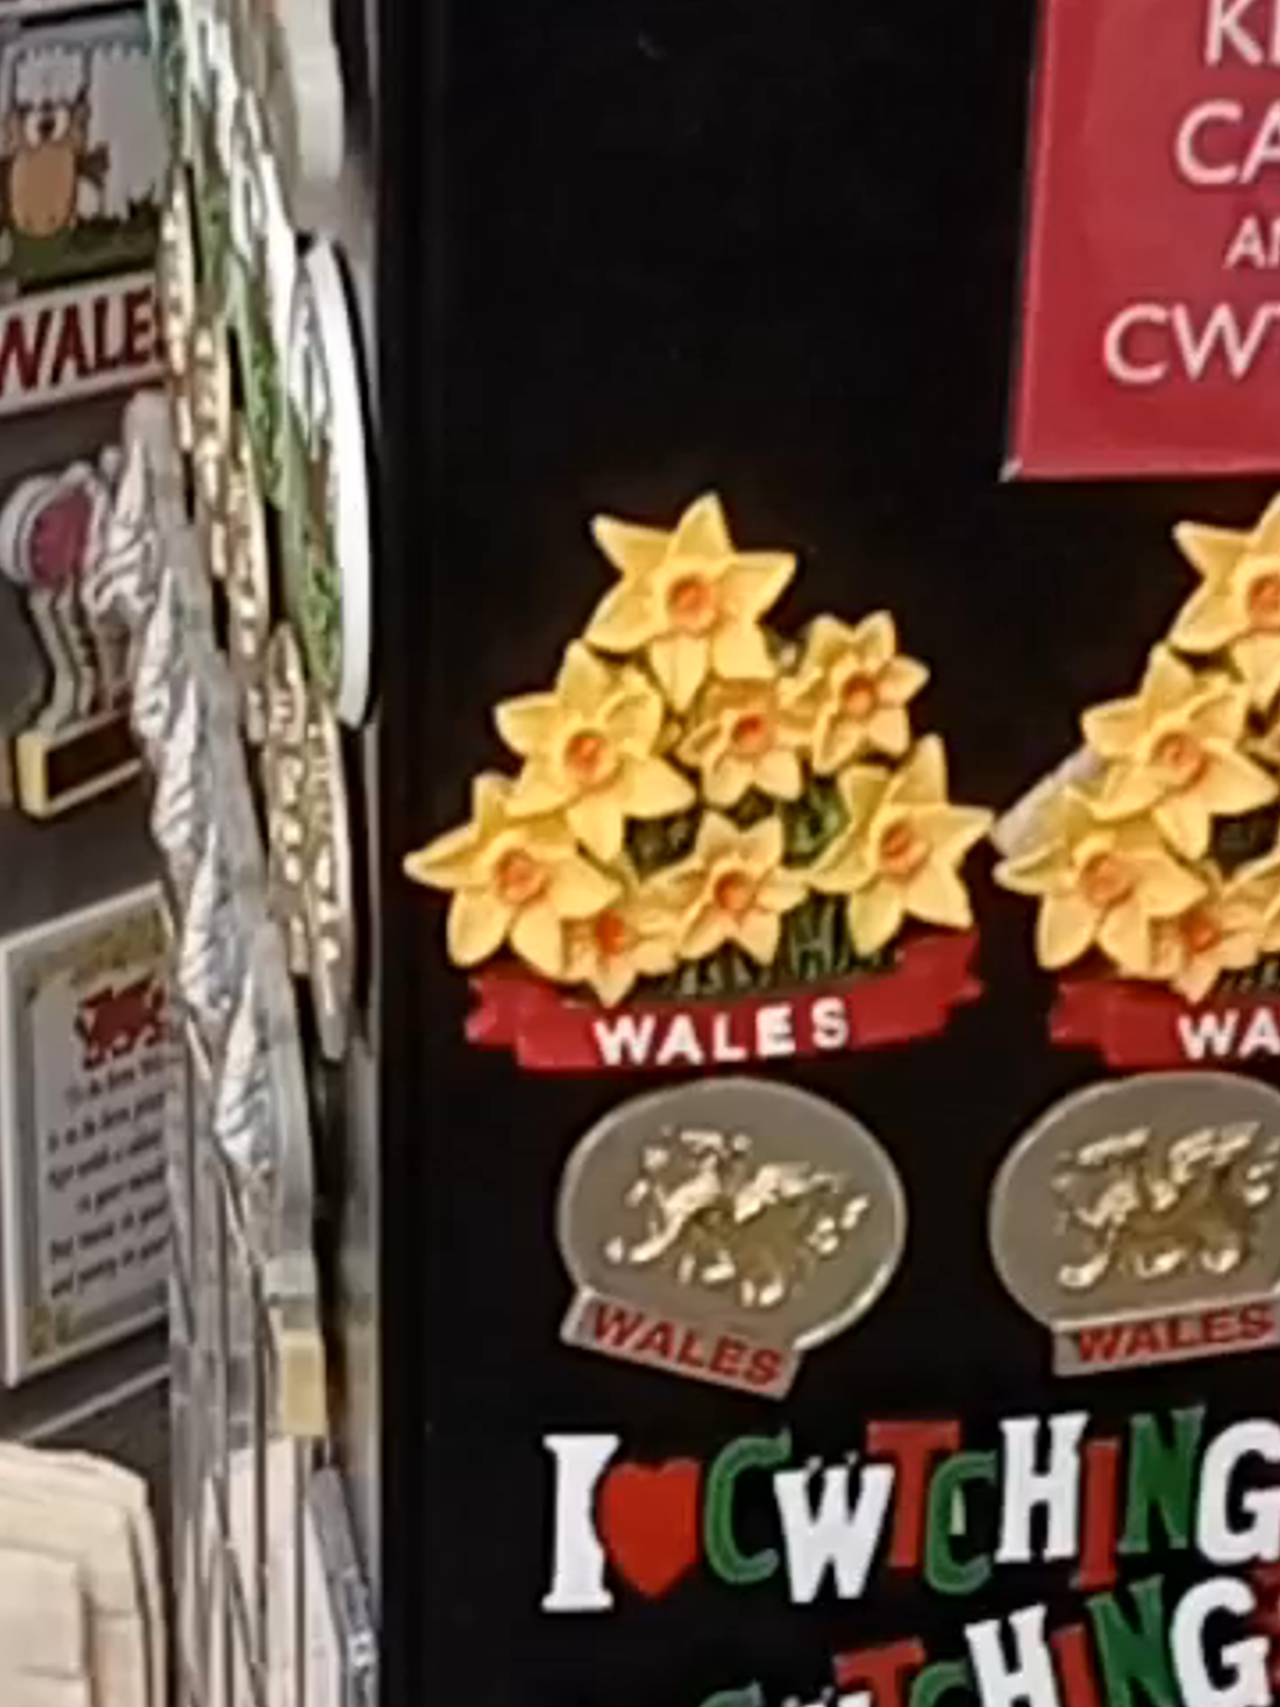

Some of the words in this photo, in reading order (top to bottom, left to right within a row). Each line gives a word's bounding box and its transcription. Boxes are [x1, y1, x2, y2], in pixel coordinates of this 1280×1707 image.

[593, 996, 851, 1069] WALES
[589, 1304, 785, 1390] WALES
[1073, 1304, 1277, 1364] WALES
[541, 1433, 621, 1611] I
